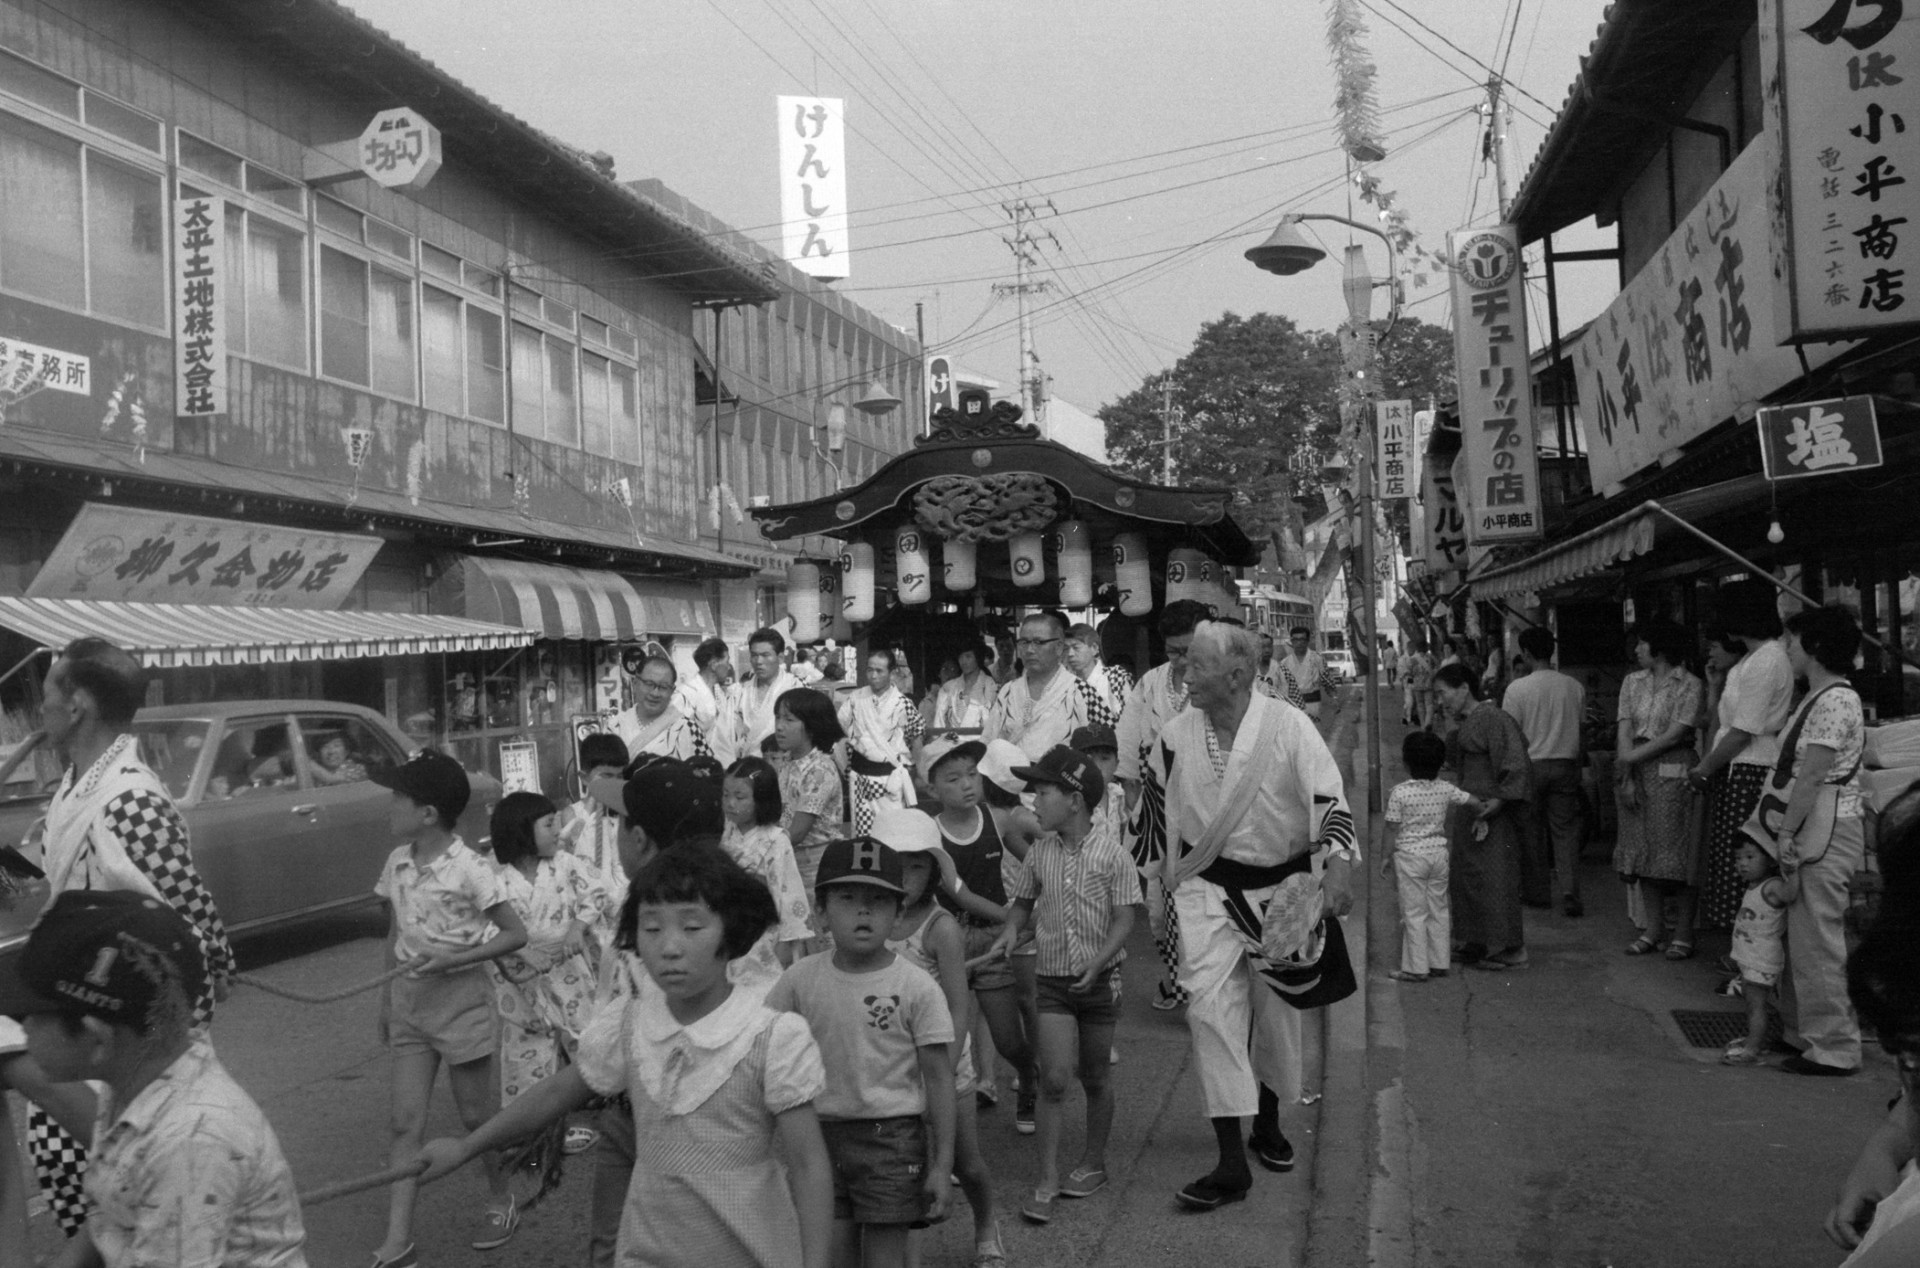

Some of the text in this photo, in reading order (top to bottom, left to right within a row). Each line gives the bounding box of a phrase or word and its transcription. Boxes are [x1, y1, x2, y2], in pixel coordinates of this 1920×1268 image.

[795, 103, 833, 258] けんしん
[1849, 103, 1908, 312] 小平商店
[182, 200, 215, 414] 太平土地株式会社
[1471, 289, 1525, 507] チューリップの店
[1384, 424, 1405, 495] 小平商店
[1786, 406, 1858, 471] 塩
[1482, 512, 1533, 530] 小平商店
[1061, 771, 1084, 791] GIANTS
[851, 841, 882, 871] H
